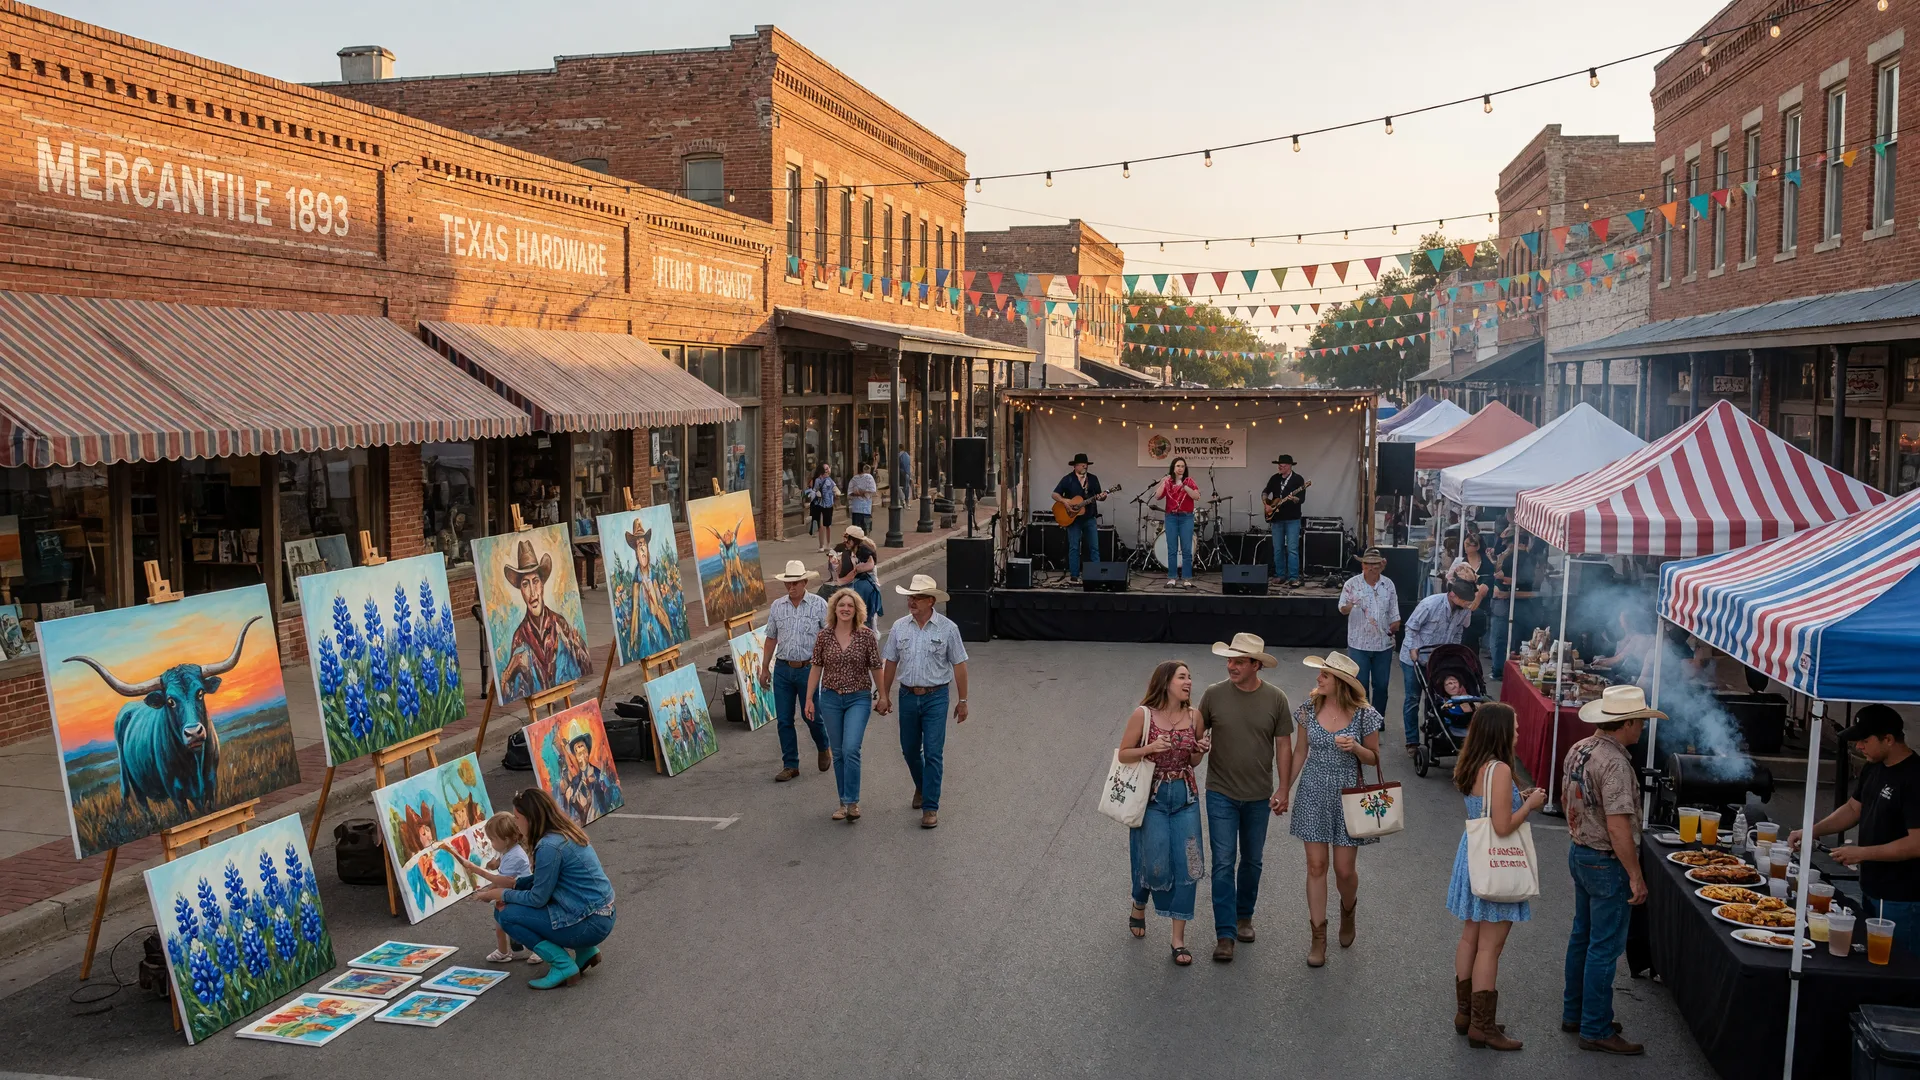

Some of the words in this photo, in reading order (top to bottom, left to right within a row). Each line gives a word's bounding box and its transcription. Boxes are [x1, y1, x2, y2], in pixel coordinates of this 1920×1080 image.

[37, 136, 273, 227] MERCANTILE
[286, 186, 349, 237] 1893
[439, 213, 509, 262] TEXAS
[516, 228, 608, 278] HARDWARE
